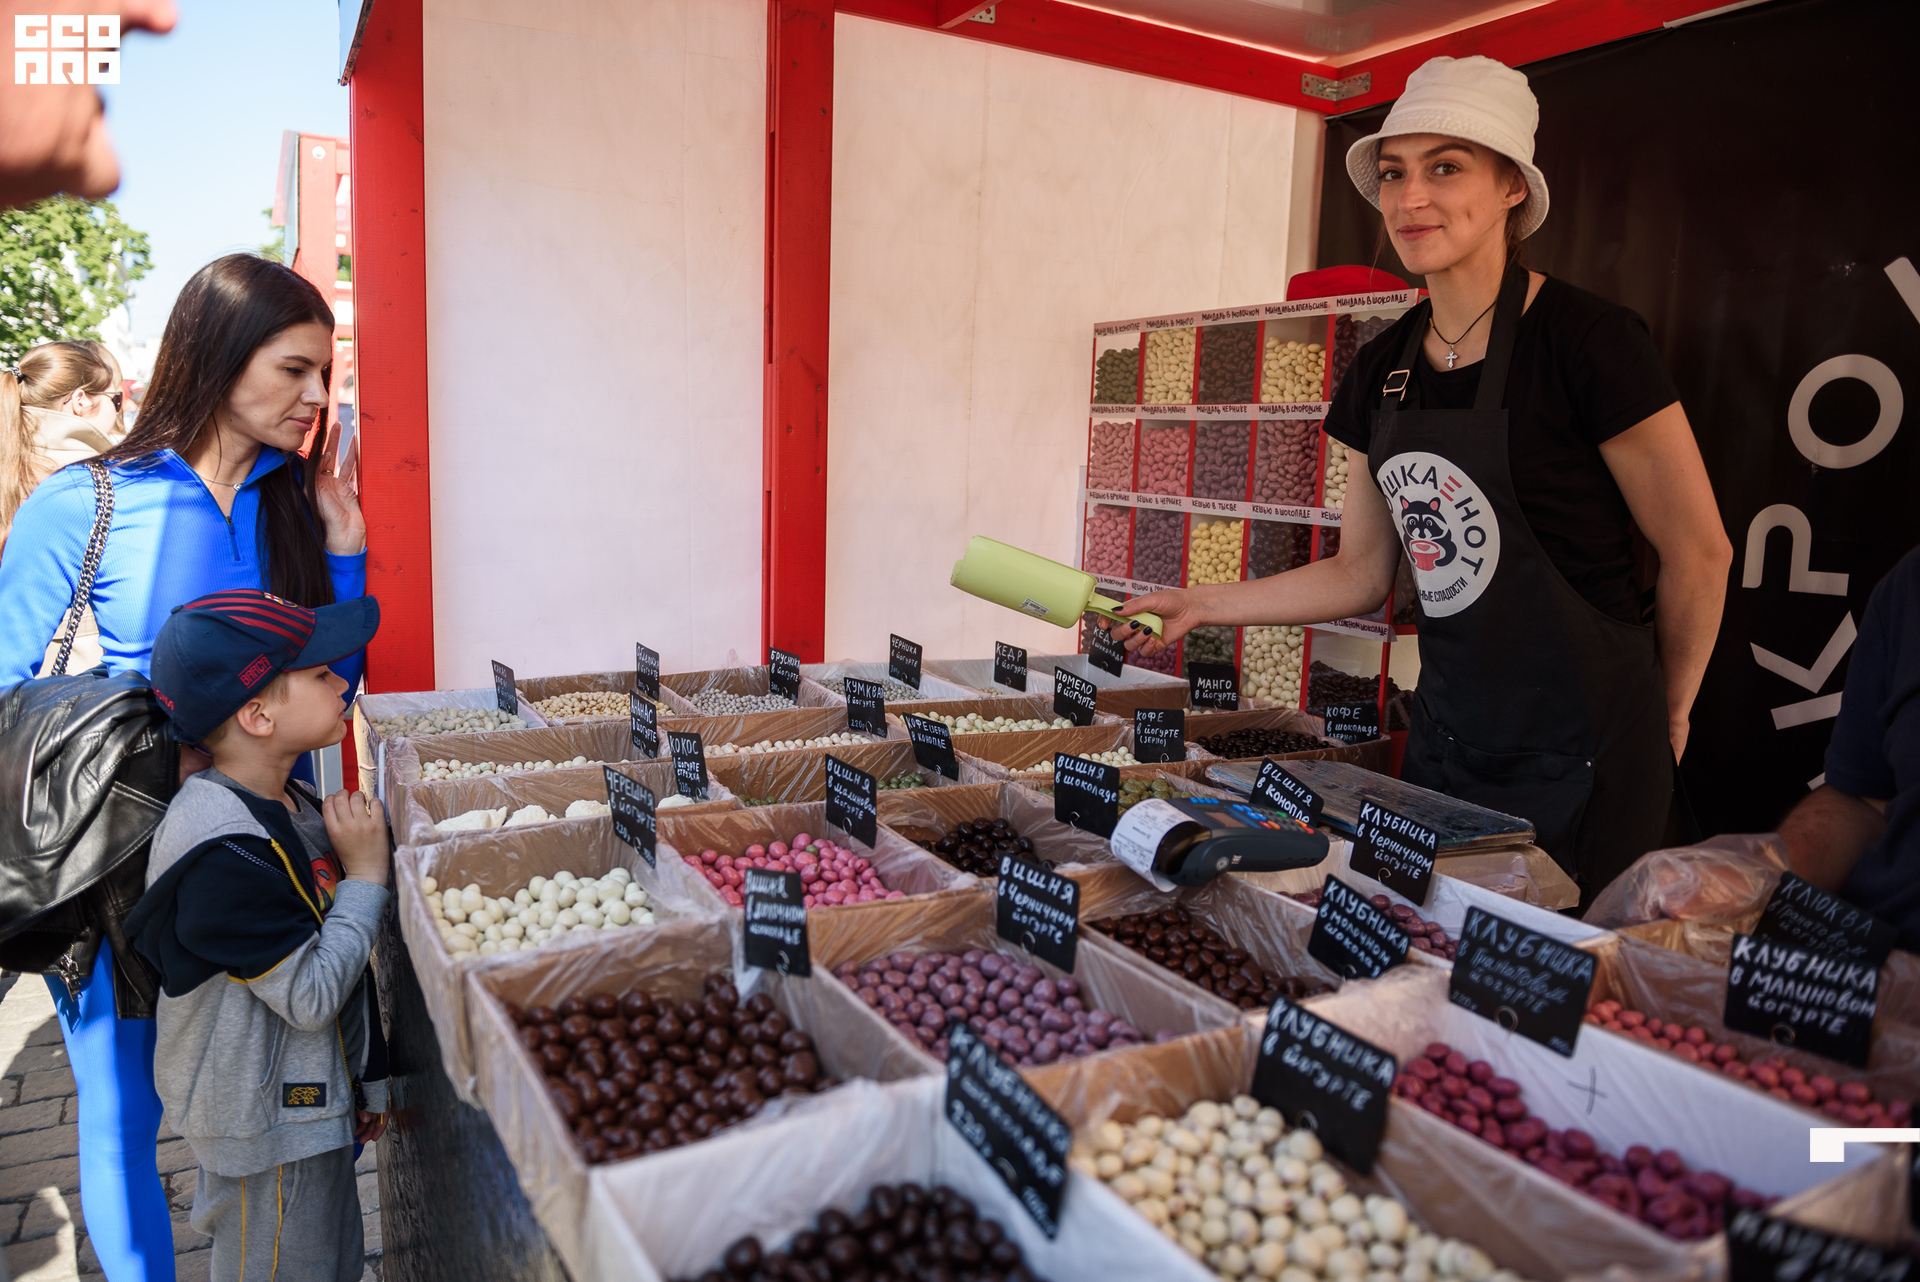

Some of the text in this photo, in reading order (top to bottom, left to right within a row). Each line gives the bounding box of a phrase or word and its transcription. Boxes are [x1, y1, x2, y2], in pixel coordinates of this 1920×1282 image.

[1372, 294, 1408, 305] ШОКОЛАДЕ
[1176, 318, 1194, 326] МАНГО
[1280, 509, 1310, 518] ШОКОЛАДЕ
[1434, 576, 1468, 602] СЛАДОСТИ
[892, 636, 917, 655] ЧЕРНИКА
[996, 642, 1022, 662] КЕДР
[1056, 670, 1092, 694] ПОМЕЛО
[1197, 678, 1232, 690] МАНГО
[906, 716, 928, 732] КОФЕ
[1136, 710, 1164, 722] КОФЕ
[1326, 706, 1362, 720] КОФЕ
[670, 734, 698, 756] КОКОС
[606, 769, 654, 812] ЧЕРЕШНЯ
[1360, 802, 1436, 850] КЛУБНИКА
[1324, 880, 1410, 955] КЛУБНИКА
[1781, 878, 1874, 938] КЛЮКВА
[1466, 911, 1593, 984] КЛУБНИКА
[1732, 935, 1878, 995] КЛУБНИКА
[1268, 996, 1394, 1088] КЛУБНИКА
